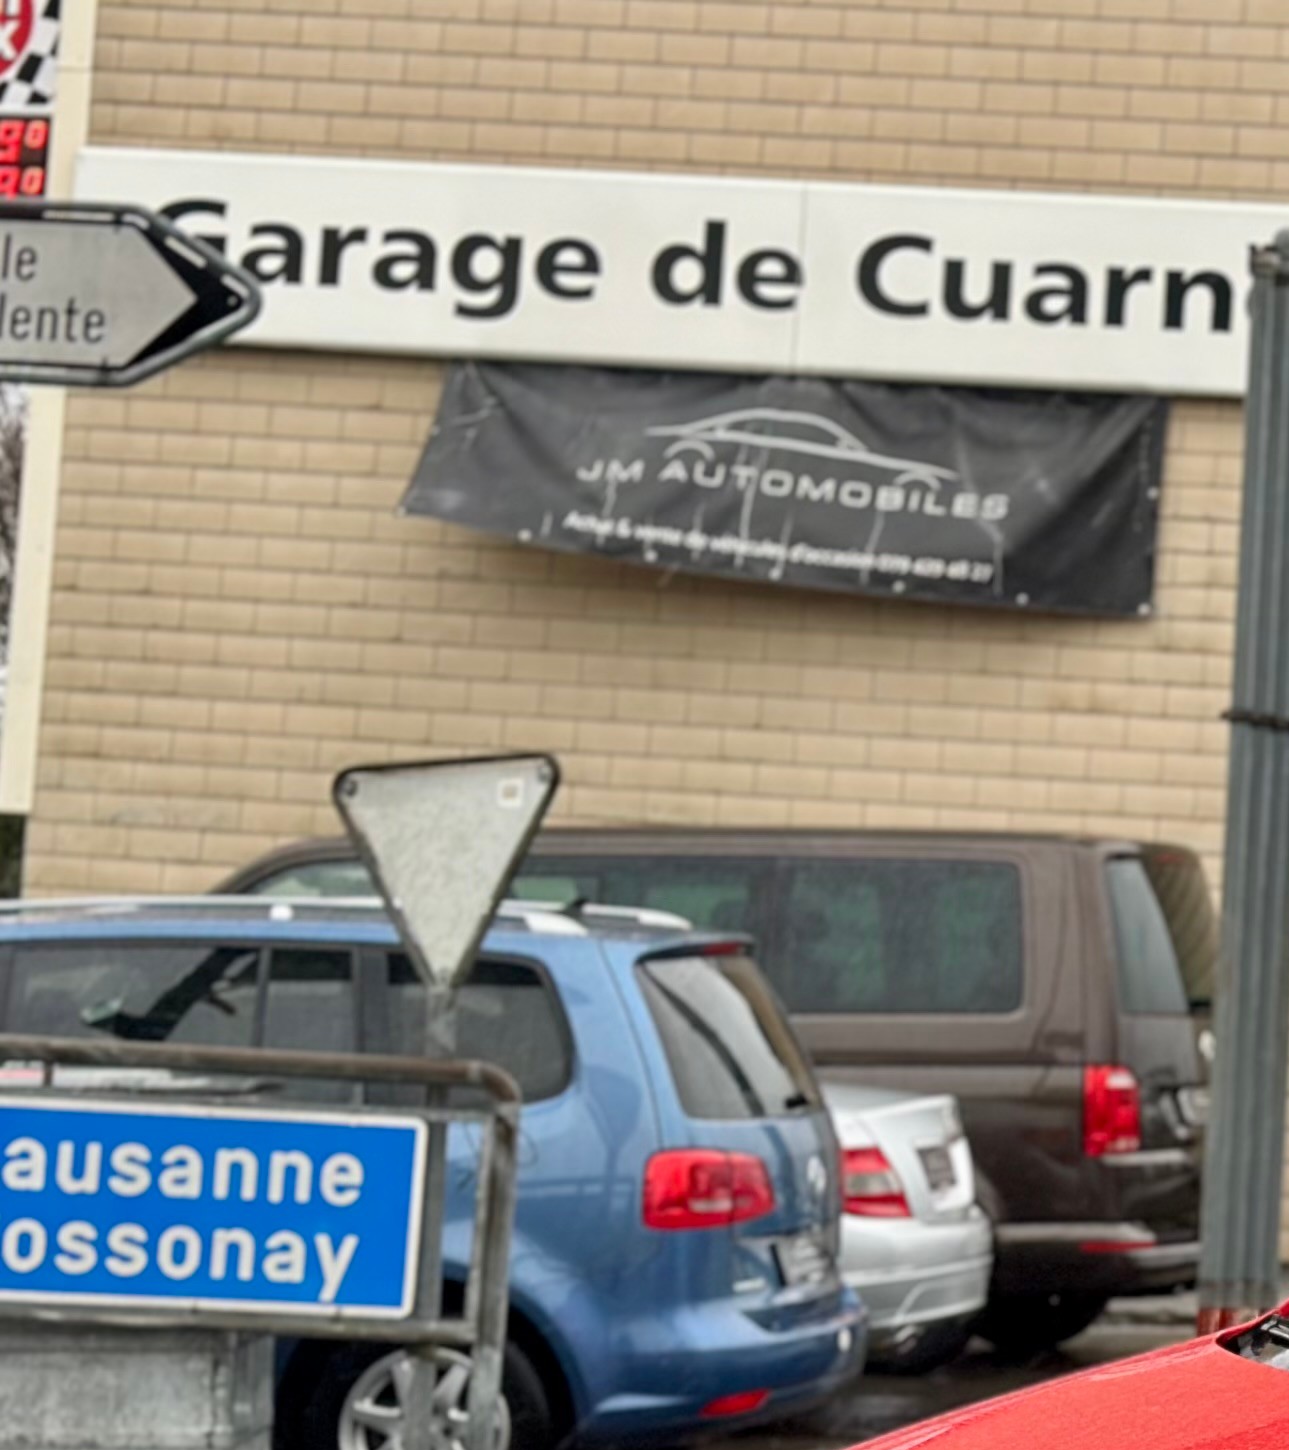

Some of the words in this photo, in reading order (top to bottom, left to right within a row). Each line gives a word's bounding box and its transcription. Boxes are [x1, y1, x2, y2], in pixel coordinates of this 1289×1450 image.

[650, 220, 802, 309] de
[577, 459, 645, 484] JM
[658, 459, 1010, 521] AUTOMOBILES
[1, 1137, 364, 1206] ausanne
[2, 1218, 359, 1303] ossonay
